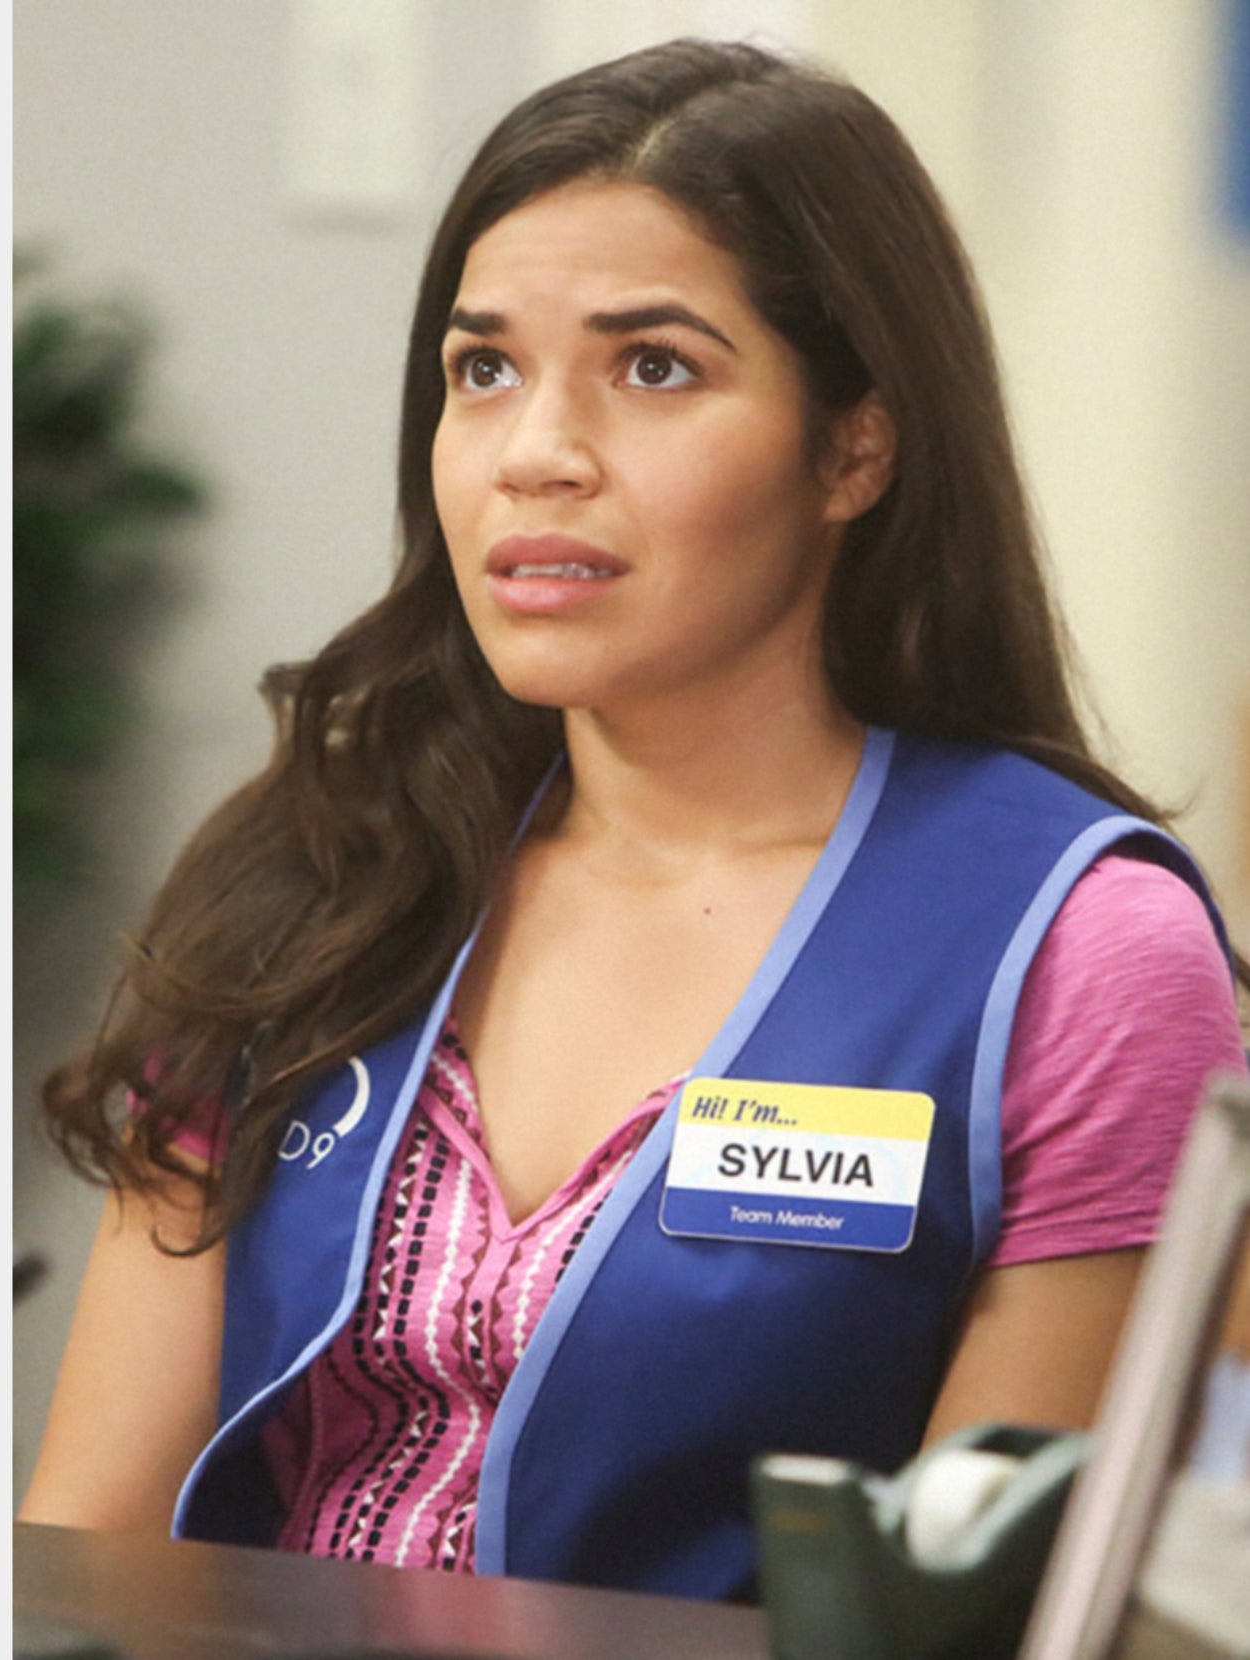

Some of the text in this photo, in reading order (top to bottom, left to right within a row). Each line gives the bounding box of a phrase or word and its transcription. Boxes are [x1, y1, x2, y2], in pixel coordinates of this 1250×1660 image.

[691, 1096, 728, 1120] Hi!
[717, 1143, 873, 1187] SYLVIA
[730, 1205, 844, 1230] Team Member
